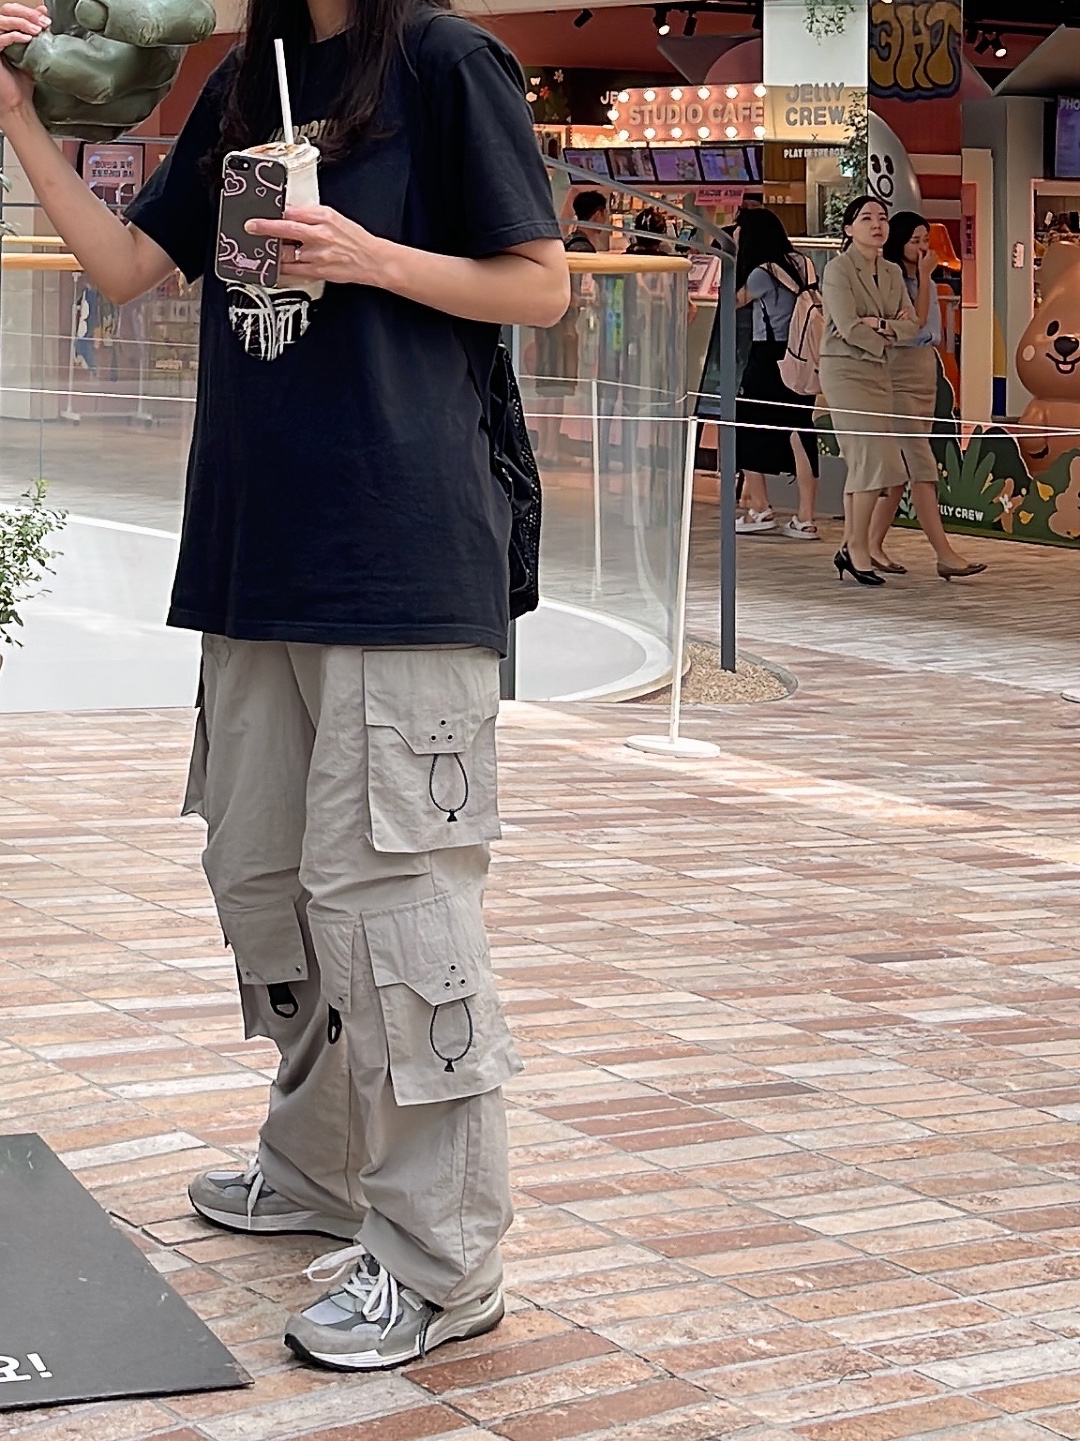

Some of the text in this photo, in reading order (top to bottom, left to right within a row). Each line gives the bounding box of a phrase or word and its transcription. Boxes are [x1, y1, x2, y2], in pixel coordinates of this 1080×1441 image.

[785, 82, 845, 103] JELLY
[629, 101, 764, 126] STUDIO CAFE
[1059, 98, 1080, 111] PHO
[785, 105, 846, 127] CREW
[783, 148, 803, 159] PLAY
[937, 504, 984, 522] LLY CREW
